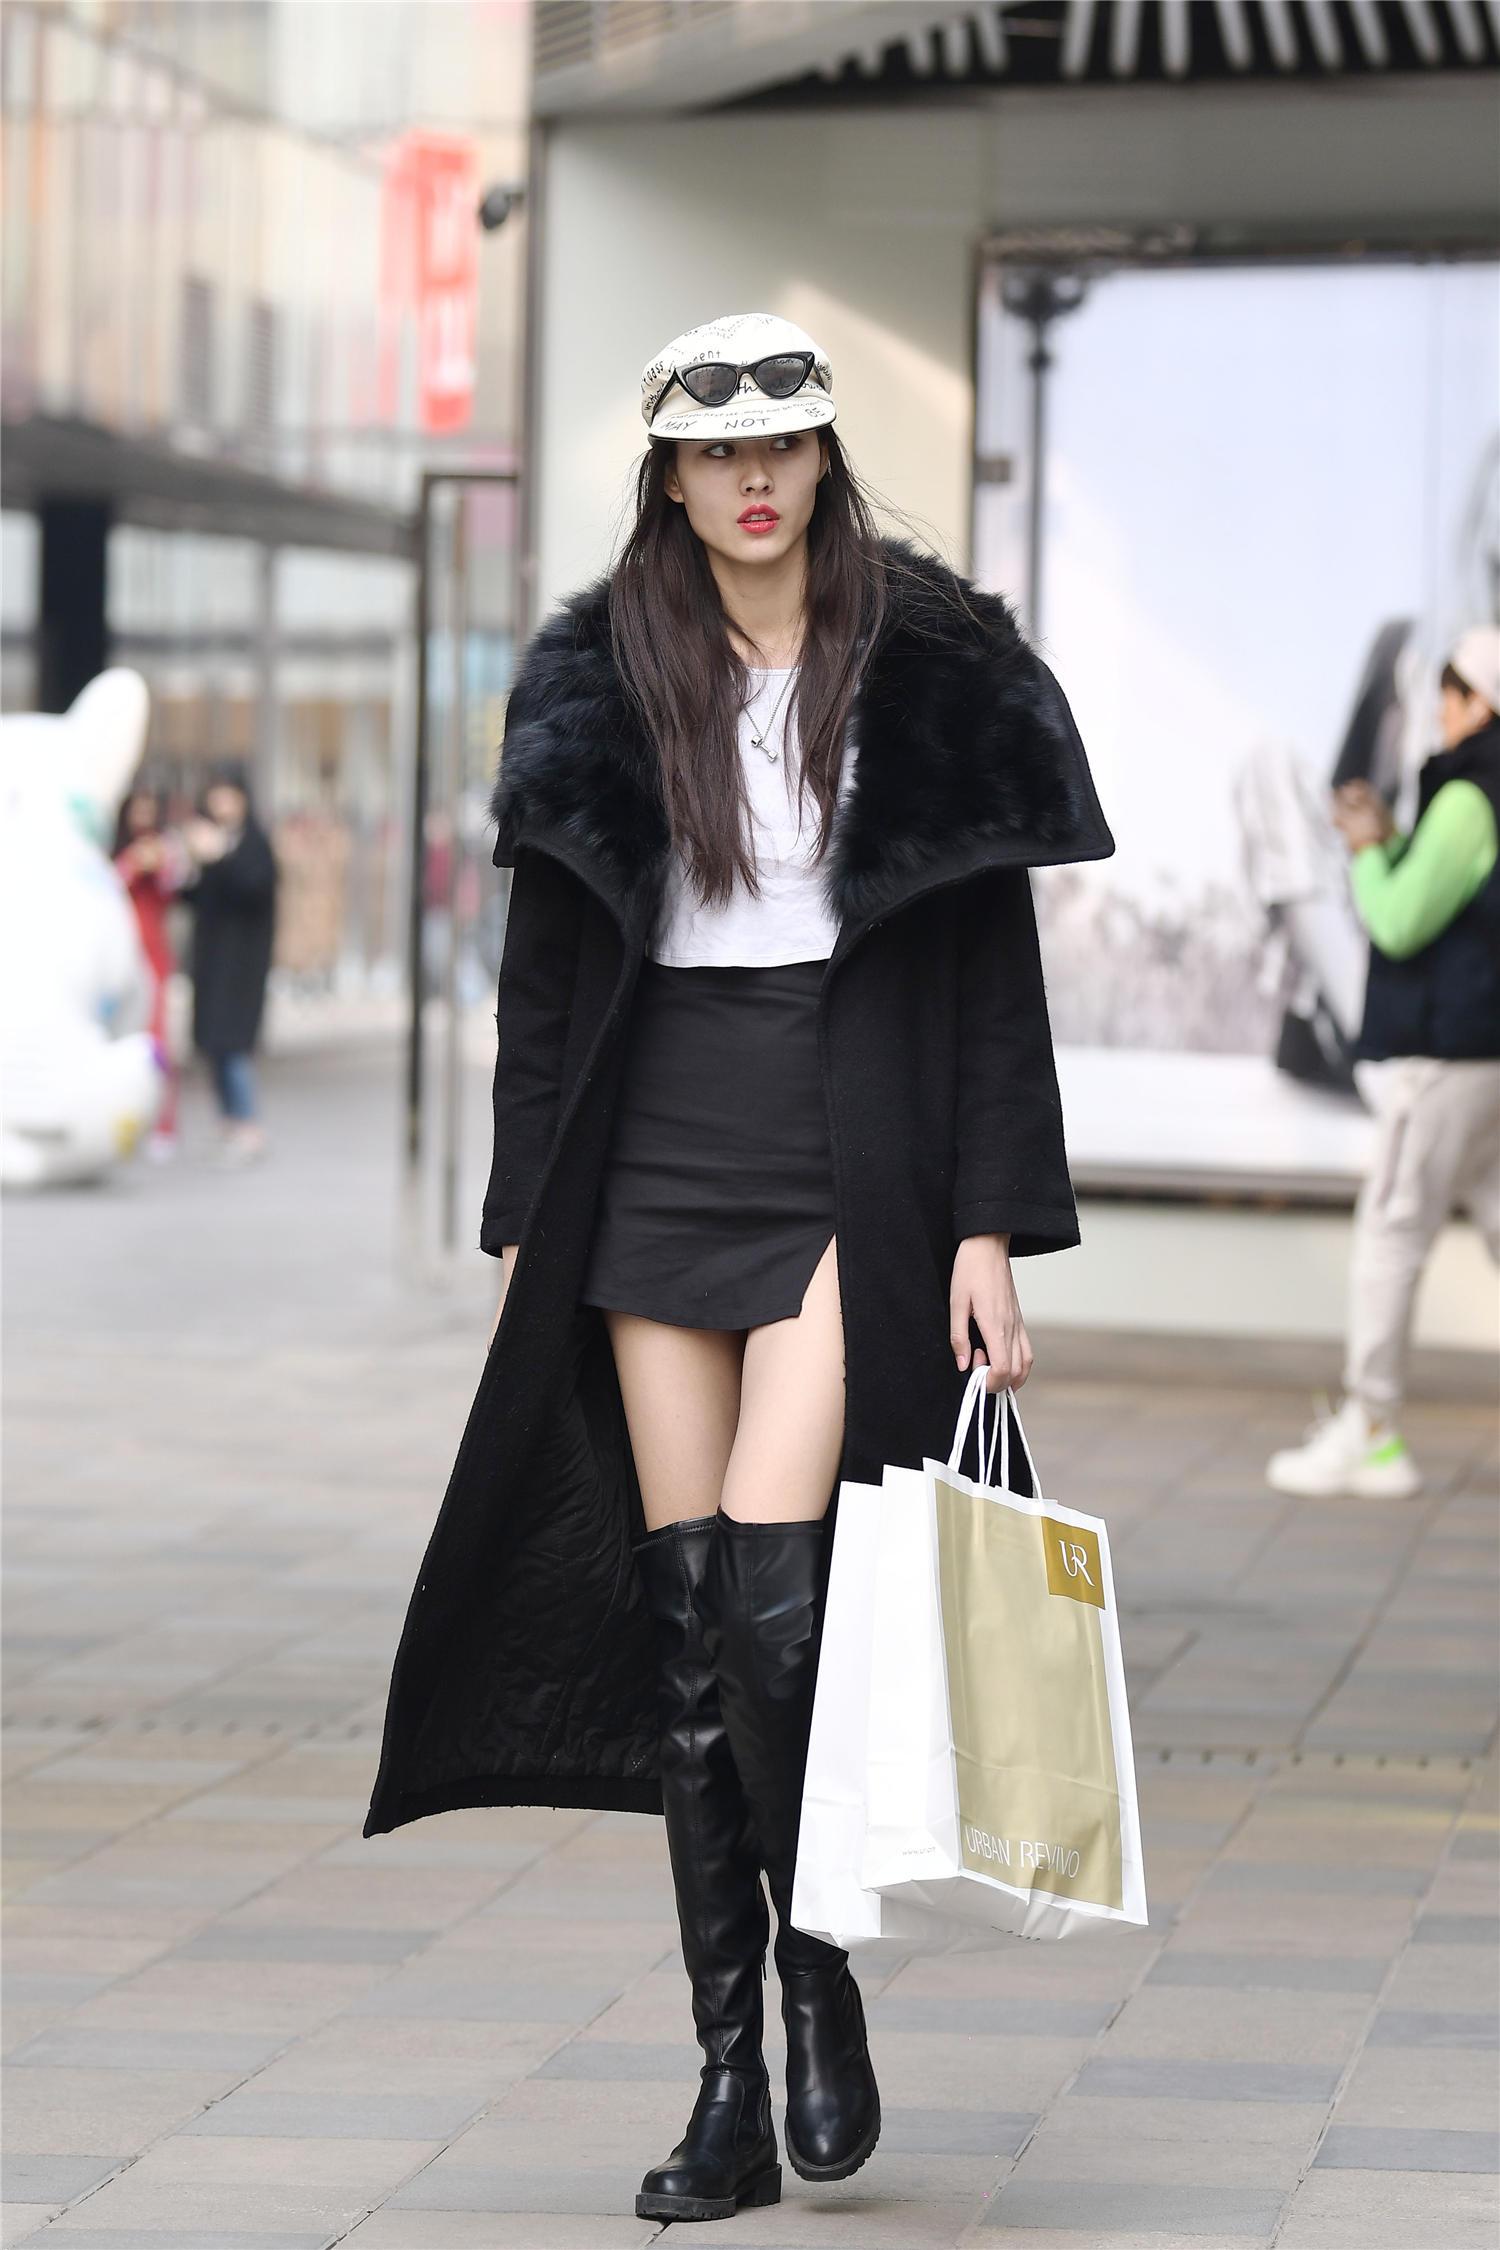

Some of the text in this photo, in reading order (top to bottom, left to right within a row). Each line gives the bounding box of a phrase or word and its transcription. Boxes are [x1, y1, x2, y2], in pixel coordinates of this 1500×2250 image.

[661, 420, 697, 432] MAY
[725, 418, 772, 430] NOT
[1058, 1539, 1095, 1587] UR
[964, 1825, 1080, 1879] URBAN REVIVO
